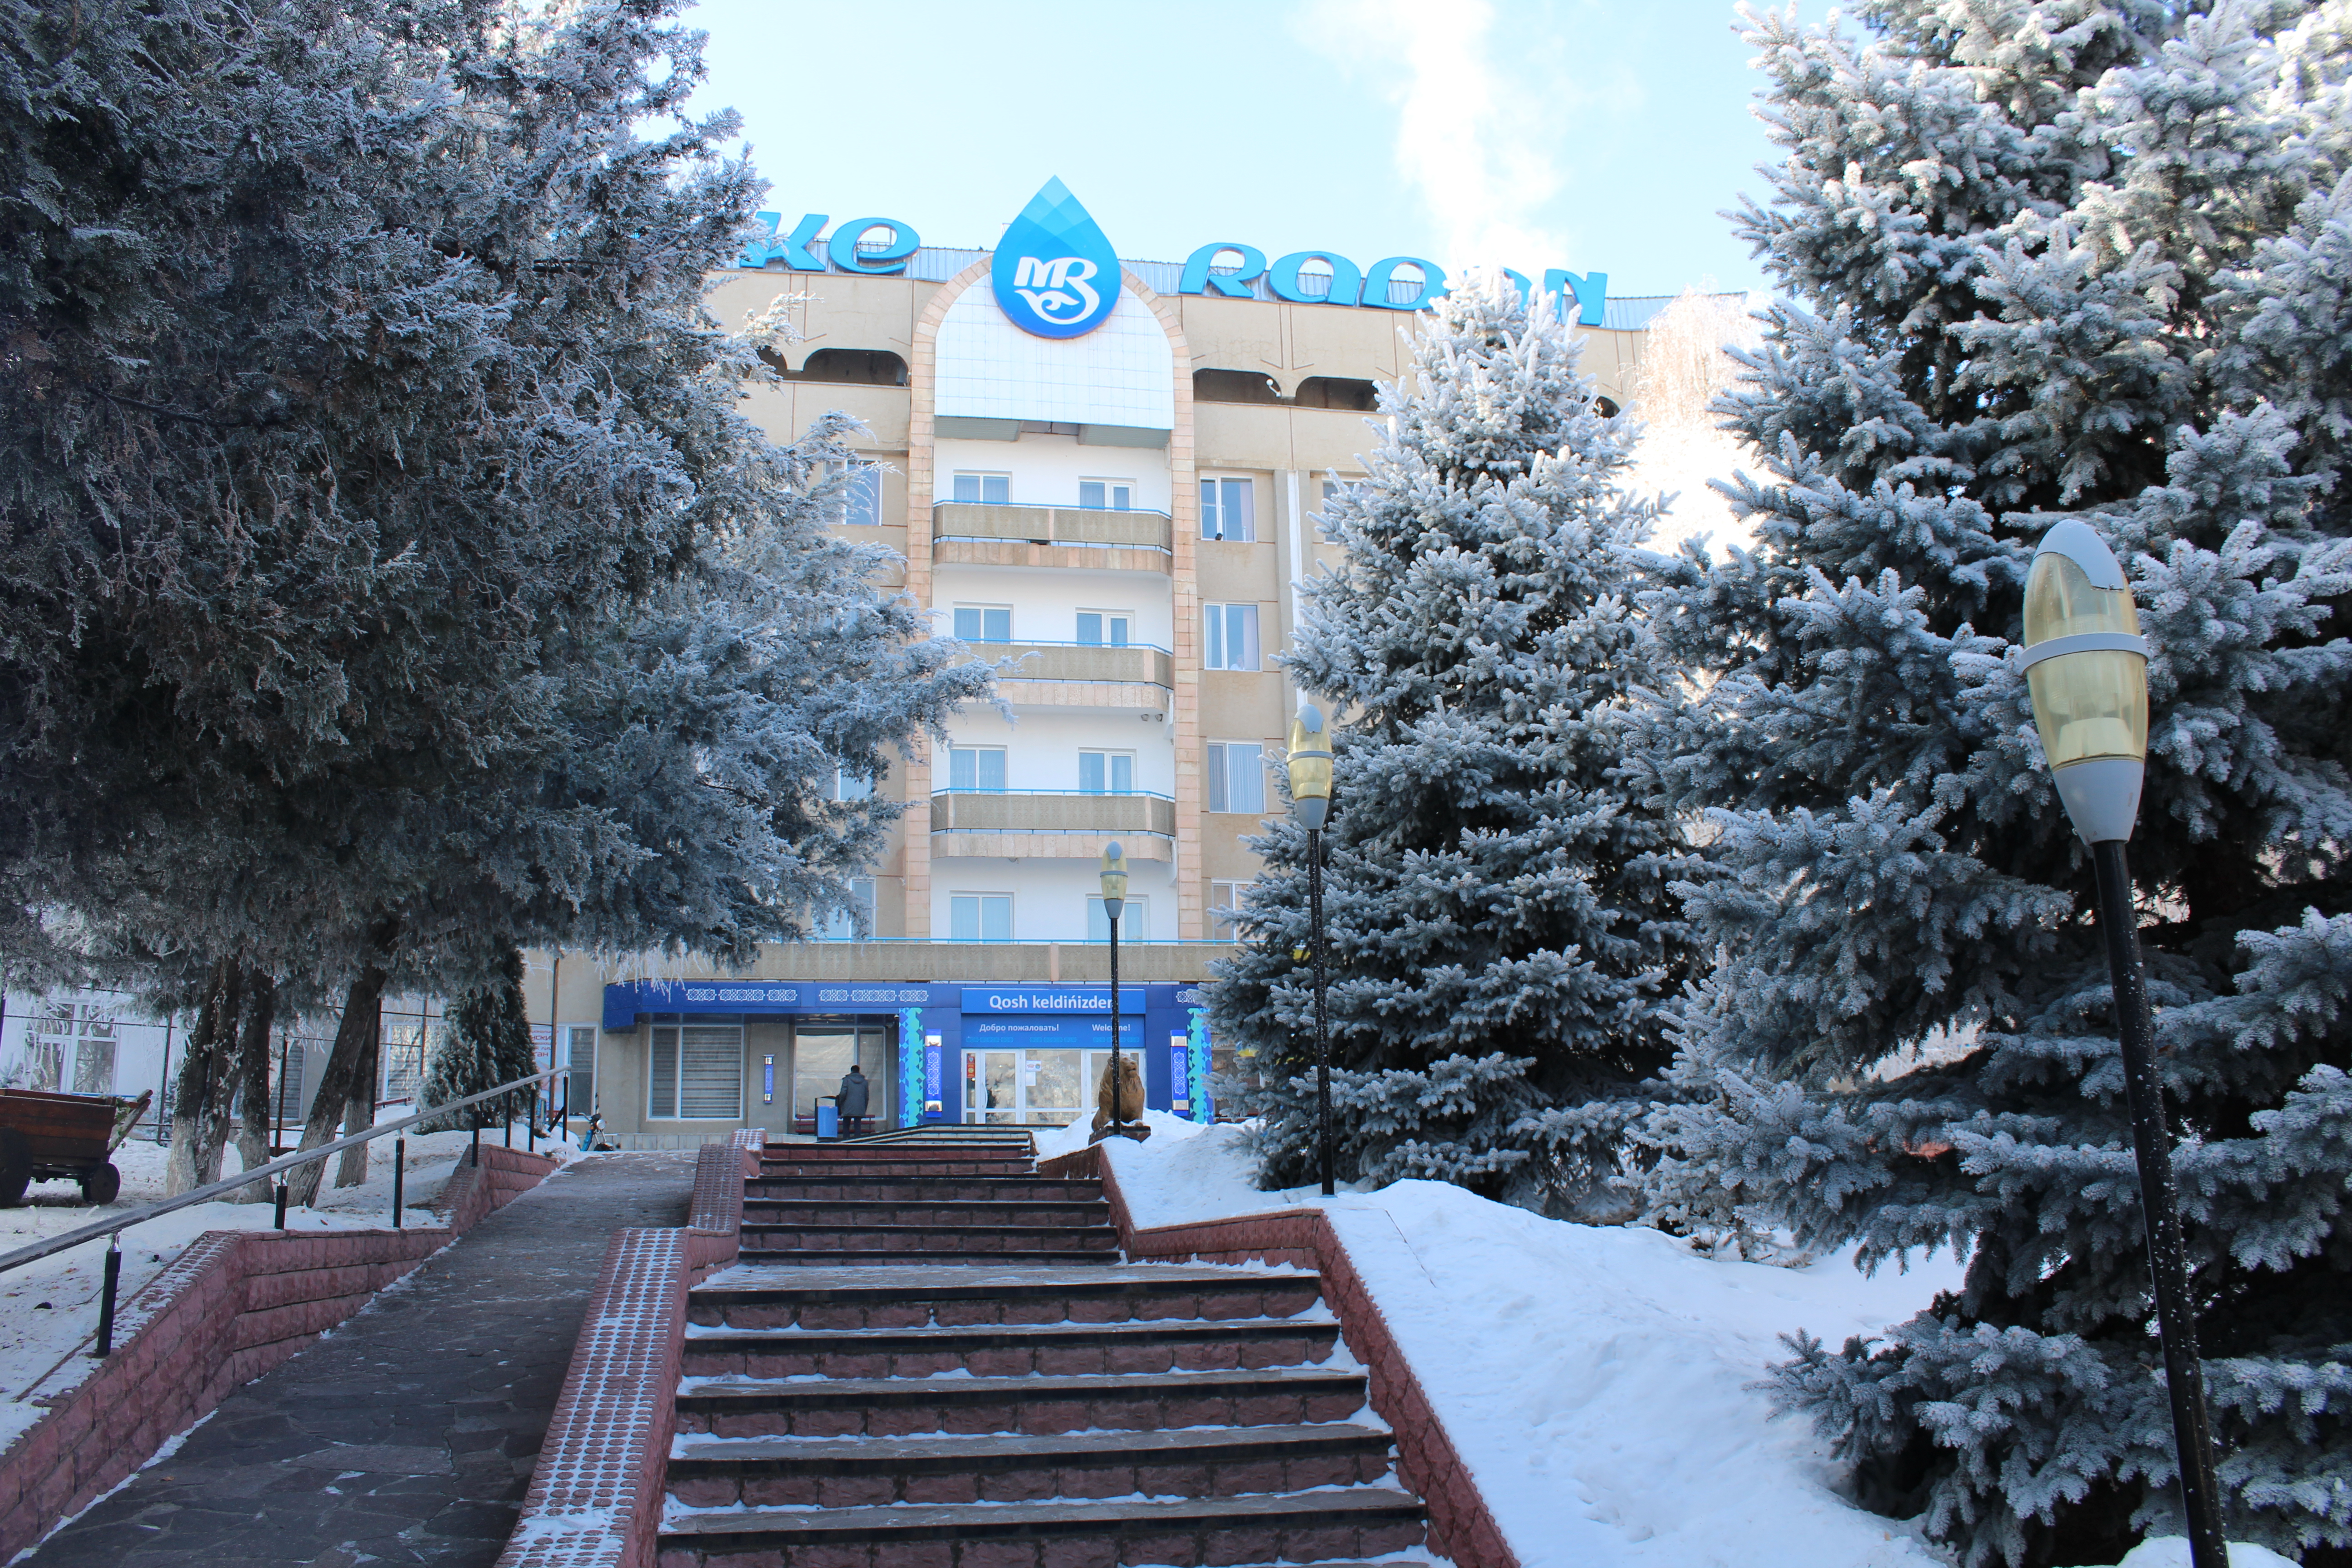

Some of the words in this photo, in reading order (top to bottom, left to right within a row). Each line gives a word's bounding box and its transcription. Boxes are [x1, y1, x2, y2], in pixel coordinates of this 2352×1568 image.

[990, 995, 1028, 1010] Qosh
[979, 1023, 1006, 1033] Добро
[1008, 1024, 1059, 1032] пожаловать!
[1092, 1024, 1131, 1032] Welcme!
